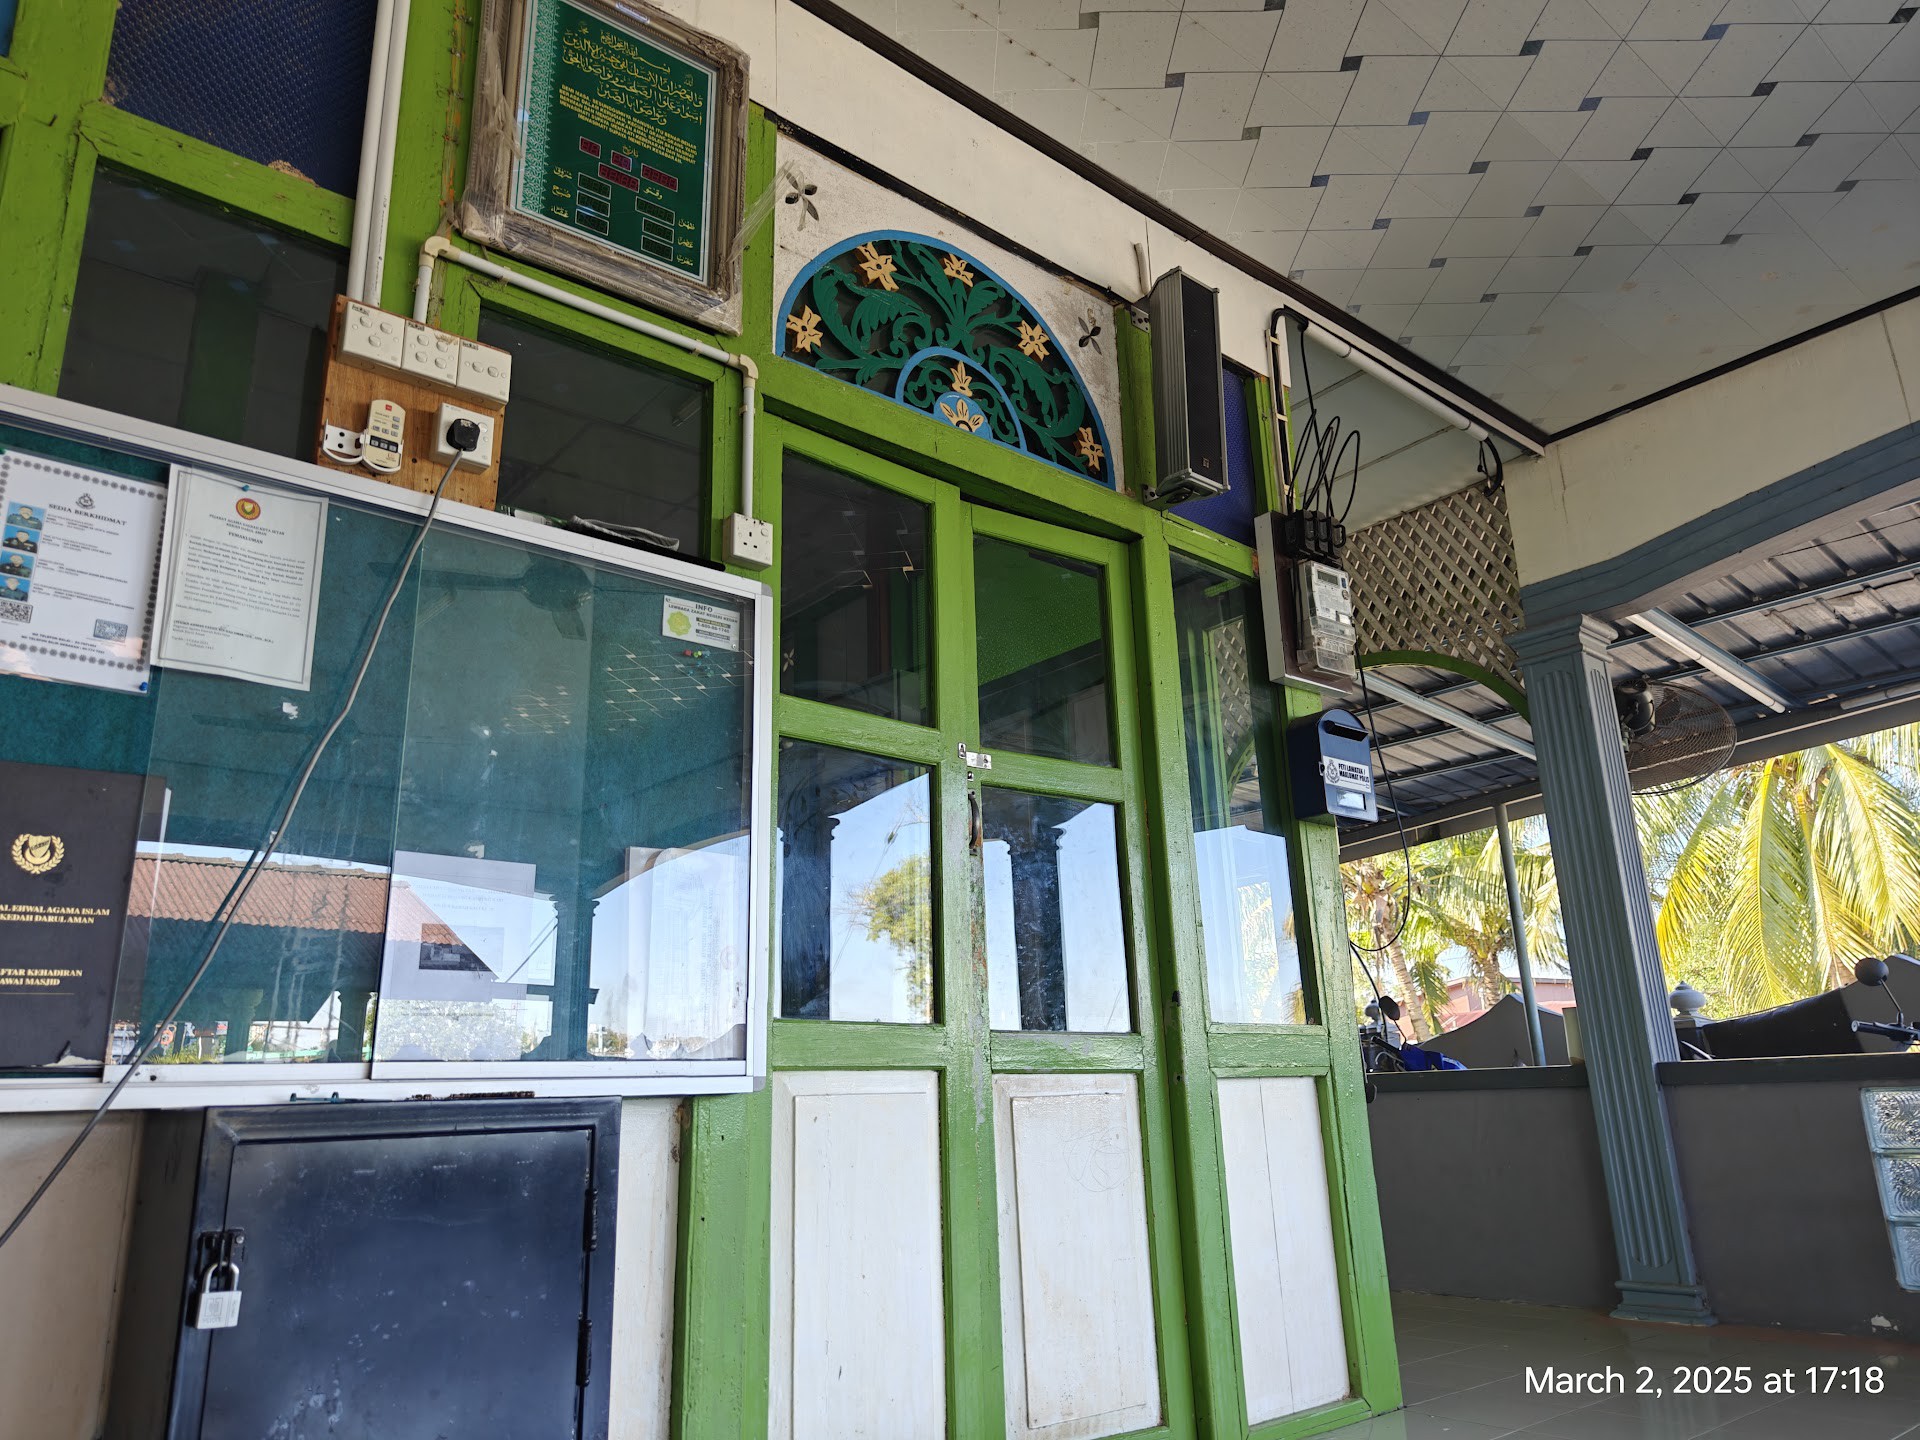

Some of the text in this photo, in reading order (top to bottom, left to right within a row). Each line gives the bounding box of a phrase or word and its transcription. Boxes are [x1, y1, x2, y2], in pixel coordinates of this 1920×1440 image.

[48, 503, 72, 514] SEDIA
[74, 509, 128, 526] BERKHIDMAT
[695, 603, 712, 612] INFO
[12, 905, 45, 913] EHWAL
[46, 906, 80, 914] AGAMA
[82, 908, 110, 916] ISLAM
[34, 915, 66, 923] DARUL
[67, 916, 94, 924] AMAN
[27, 969, 82, 977] KEHADIRAN
[25, 978, 60, 986] MASJID
